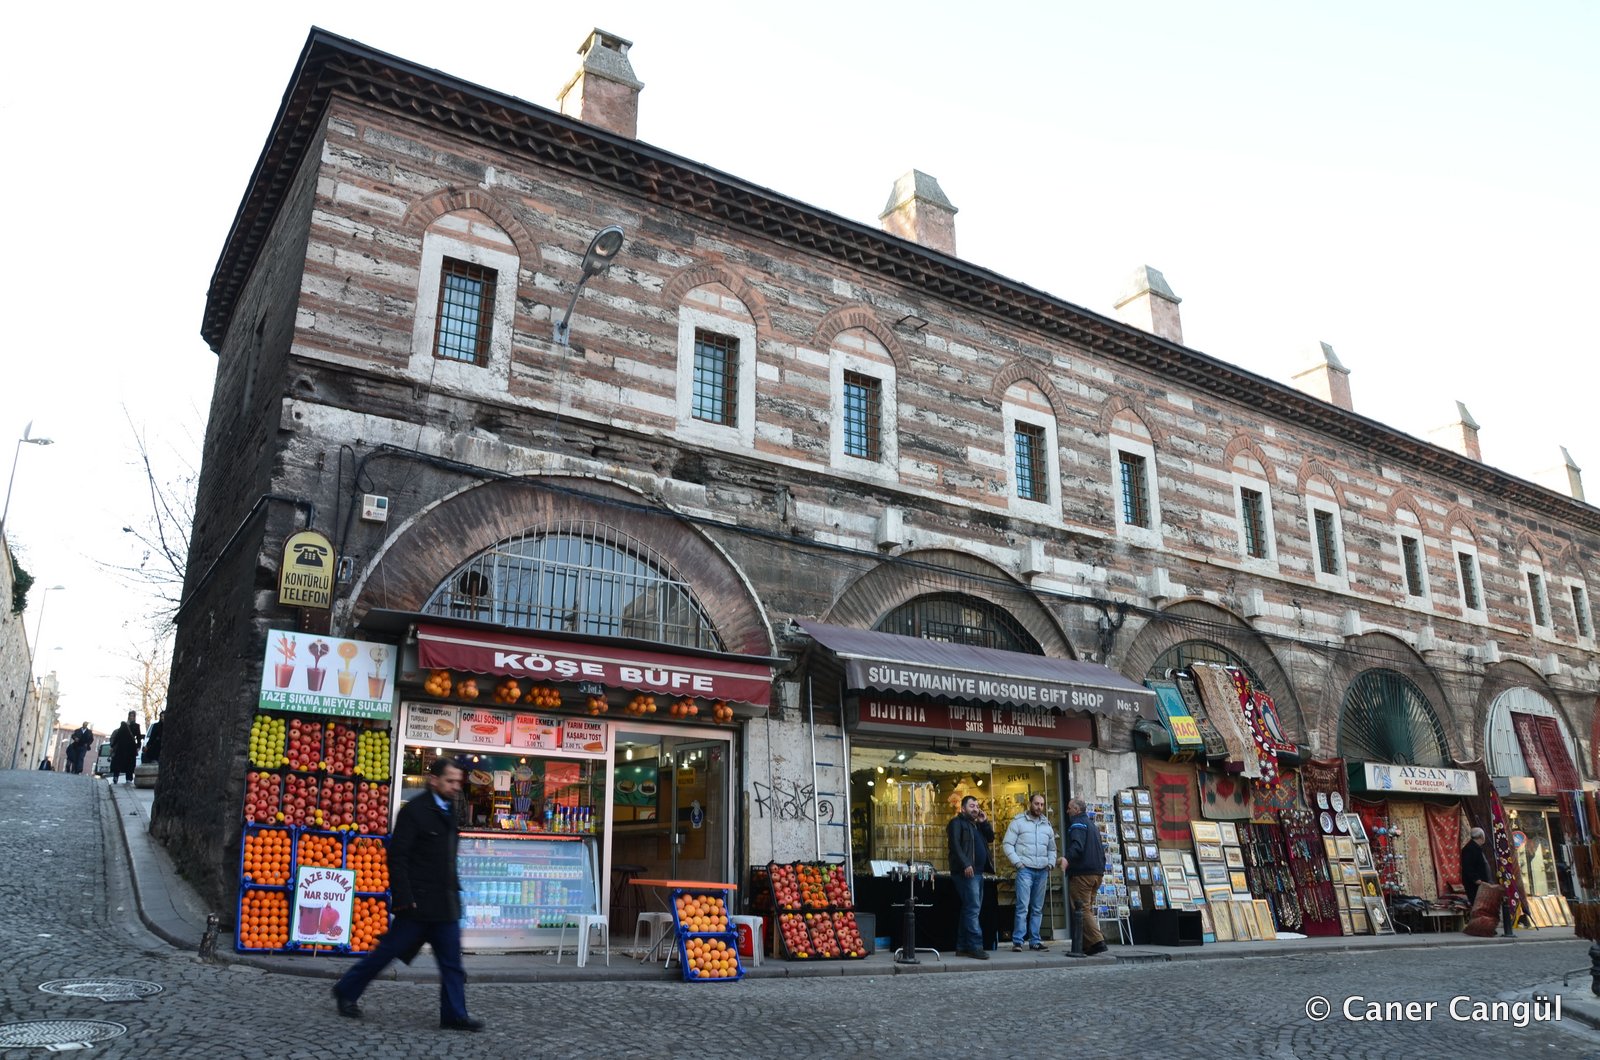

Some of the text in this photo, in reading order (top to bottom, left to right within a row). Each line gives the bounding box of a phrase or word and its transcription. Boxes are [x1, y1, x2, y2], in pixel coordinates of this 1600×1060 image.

[285, 572, 329, 590] KONTÜRLÜ
[283, 587, 329, 604] TELEFON
[494, 652, 605, 677] KÖŞE
[620, 667, 714, 692] BÜFE
[868, 665, 1140, 712] SÜLEYMANİYE MOSQUE GIFT SHOP No: 3
[261, 690, 392, 713] TAZE SIKMA MEYVE SULARI
[312, 704, 336, 715] Fruit
[340, 708, 371, 718] Juices
[948, 704, 983, 722] TOPTAN
[991, 708, 1003, 724] VE
[1011, 712, 1057, 729] PERAKENDE
[516, 716, 555, 727] YARIM EKMEK
[566, 721, 602, 731] YARIM EKMEK
[528, 733, 541, 741] TON
[588, 733, 602, 741] TOST
[1007, 772, 1030, 783] SILVER
[1399, 766, 1447, 779] AYSAN
[299, 871, 353, 893] TAZE SIKMA
[303, 890, 346, 902] NAR SUYU
